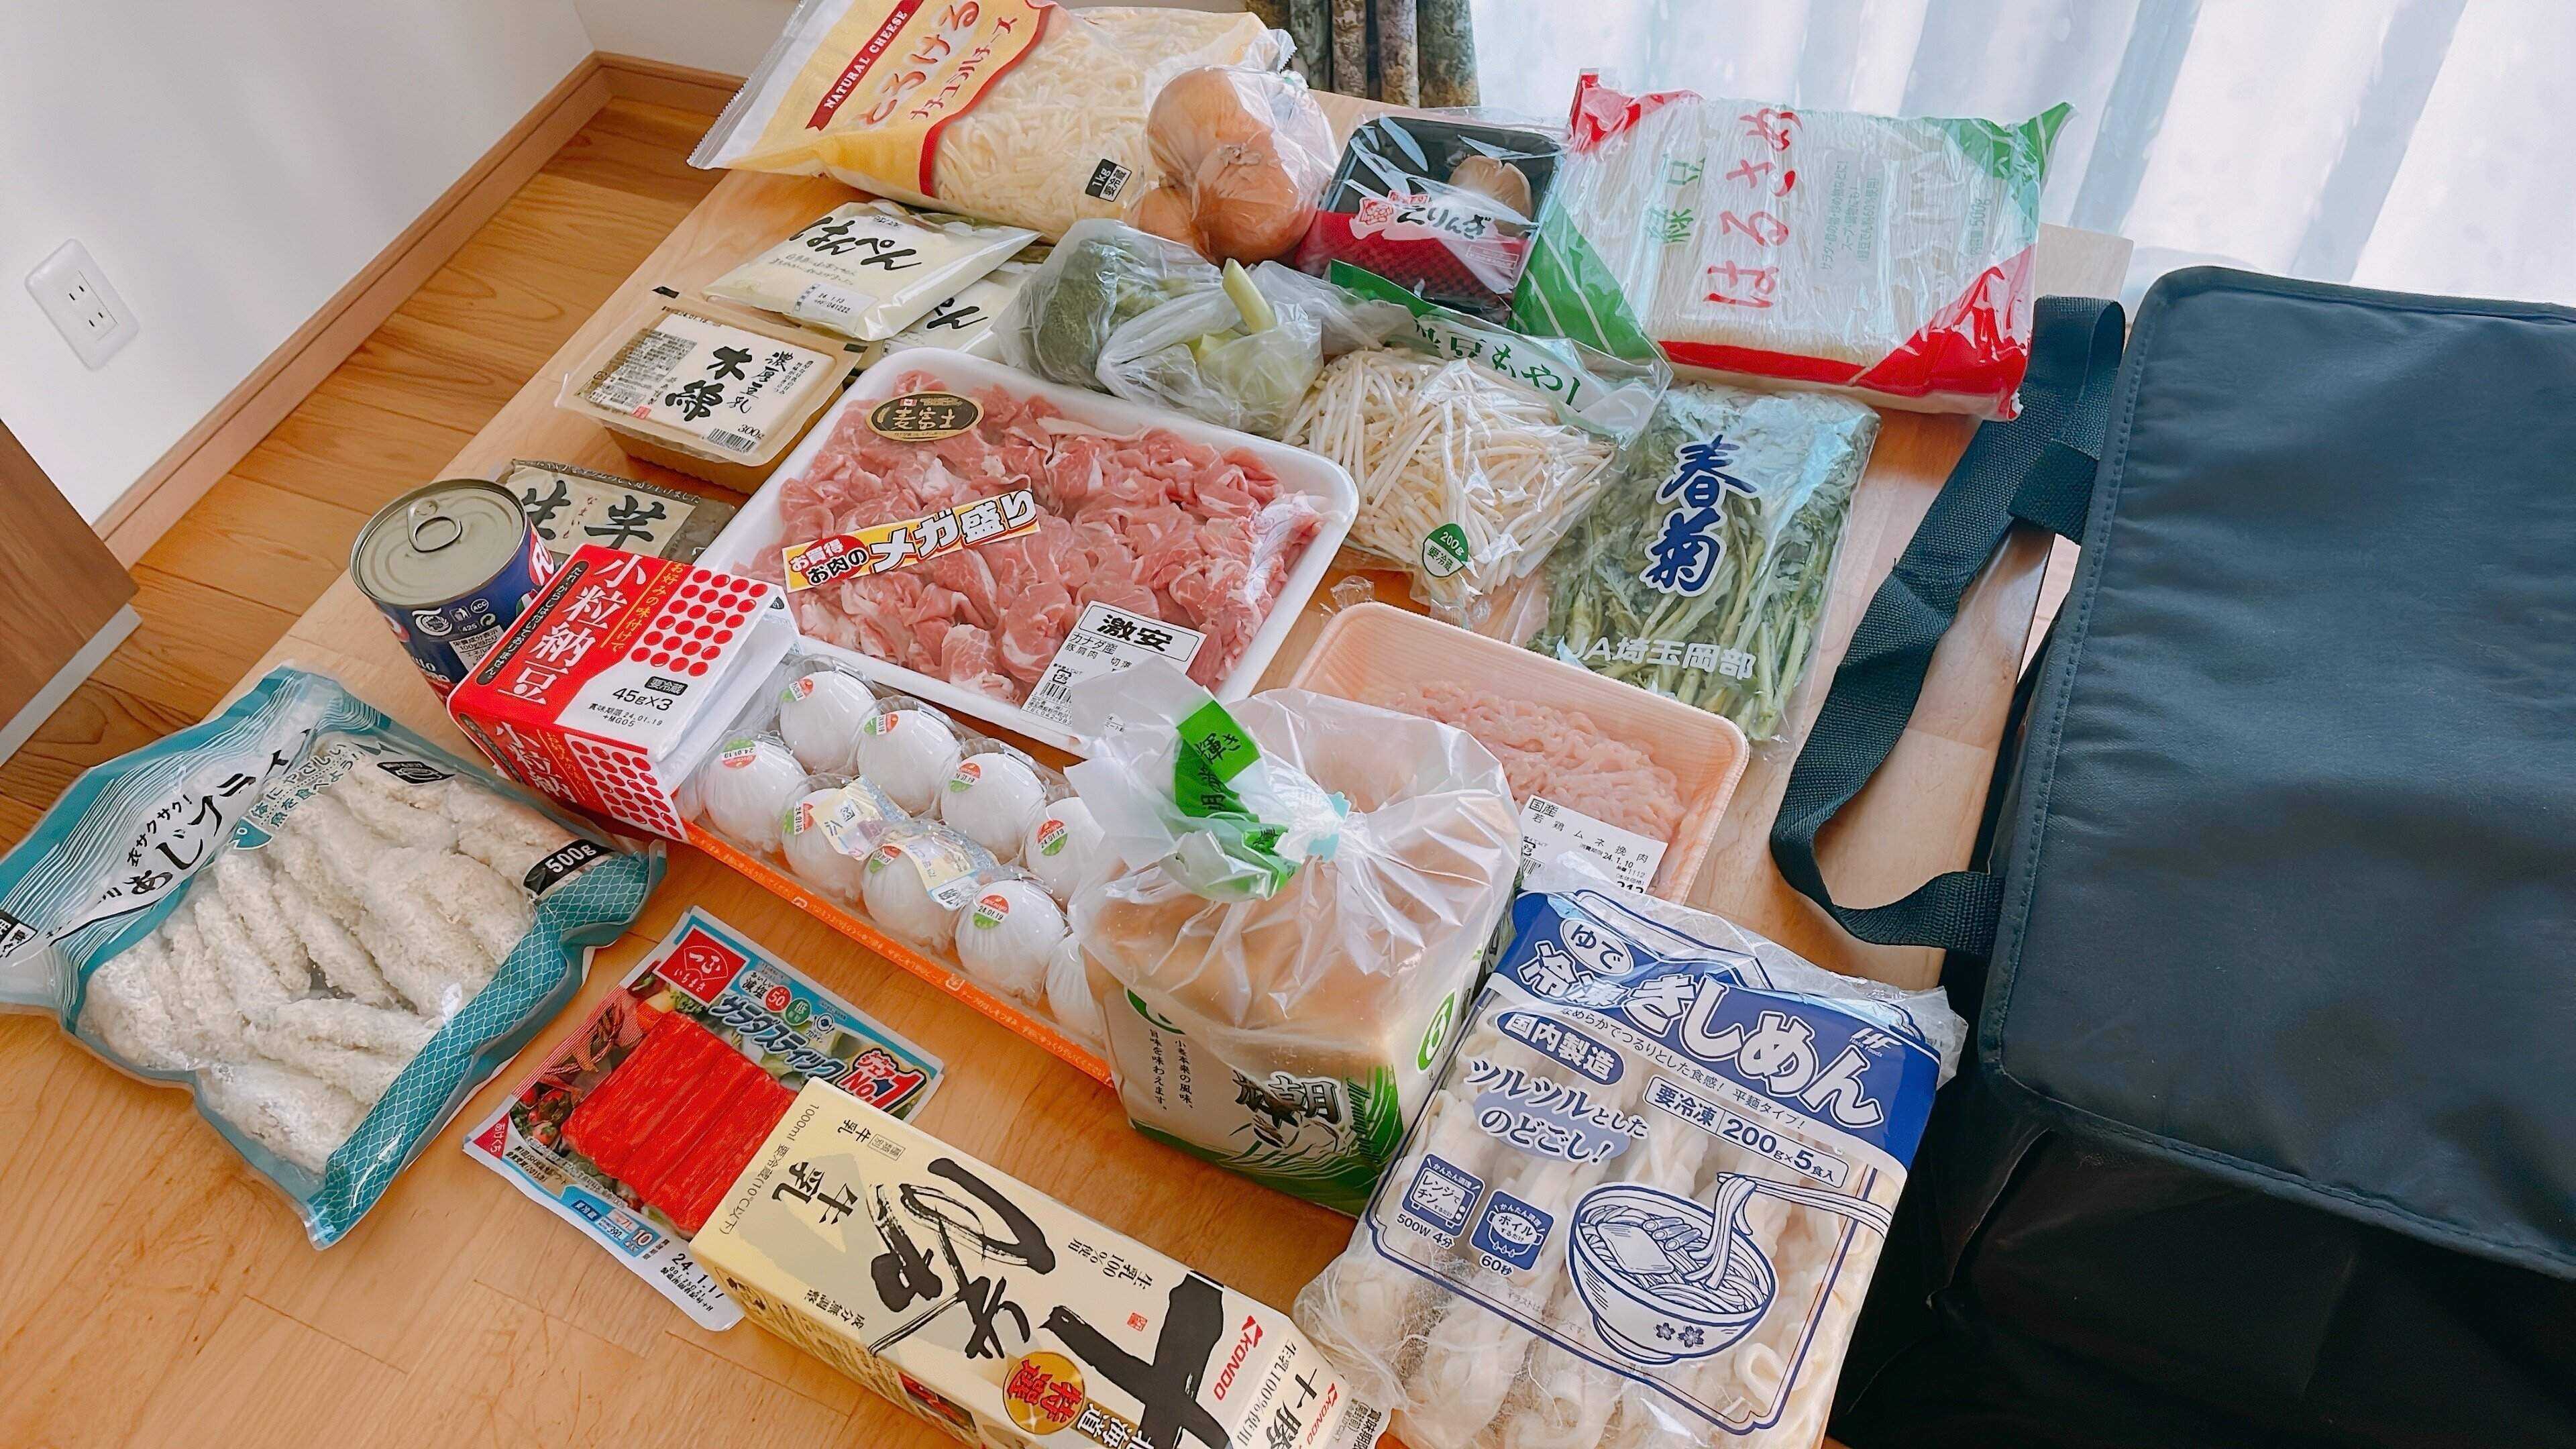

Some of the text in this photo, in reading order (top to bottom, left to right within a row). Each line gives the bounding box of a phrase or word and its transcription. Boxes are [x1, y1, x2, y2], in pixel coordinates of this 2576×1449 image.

[823, 10, 908, 109] NATURAL CHEESE
[857, 1, 979, 125] とろける
[910, 17, 1018, 120] ナチュラルチーズ
[1092, 168, 1112, 186] 1kg
[1703, 109, 1803, 307] はるさめ
[789, 216, 923, 270] はんぺん
[665, 345, 753, 422] 木綿
[726, 351, 794, 414] 濃厚豆乳
[737, 424, 765, 440] 300g
[891, 407, 955, 431] 麦富士
[869, 490, 1037, 574] メガ盛り
[1646, 434, 1758, 592] 春菊
[1427, 545, 1454, 572] 要冷蔵
[1440, 531, 1465, 556] 200g
[808, 547, 870, 586] お肉の
[472, 600, 488, 612] ACC
[610, 562, 685, 653] お好みの味付けで
[462, 624, 477, 633] 425
[498, 554, 647, 707] 小粒納豆
[1069, 633, 1118, 655] カナダ産
[1097, 614, 1173, 652] 激安
[1573, 637, 1758, 680] JA埼玉岡部
[648, 678, 684, 694] 要冷蔵
[1529, 798, 1559, 818] 国産
[545, 845, 597, 873] 500g
[1570, 924, 1623, 970] ゆで
[742, 978, 768, 1000] 減塩
[768, 991, 786, 1006] 50
[709, 994, 847, 1079] サラダスティック
[1505, 1013, 1615, 1081] 国内製造
[1623, 974, 1883, 1128] きしめん
[1562, 1008, 1806, 1130] なめらかでつるりとした食感! 平麺タイプ!
[1466, 1060, 1648, 1138] ツルツルとした
[1654, 1083, 1719, 1127] 要冷凍
[786, 1104, 820, 1142] 1000ml
[837, 1119, 872, 1143] 牛乳
[1481, 1110, 1612, 1163] のどごし!
[772, 1162, 858, 1225] 牛乳
[1422, 1175, 1461, 1203] レンジで
[631, 1229, 653, 1246] 10
[1397, 1213, 1454, 1248] 500W 4分
[1498, 1215, 1534, 1237] ボイル
[1068, 1237, 1153, 1290] 生乳100%使用
[1481, 1254, 1513, 1276] 60秒
[804, 1289, 865, 1330] 成分無調整
[1213, 1325, 1253, 1401] KONDO
[1007, 1359, 1083, 1423] 特選
